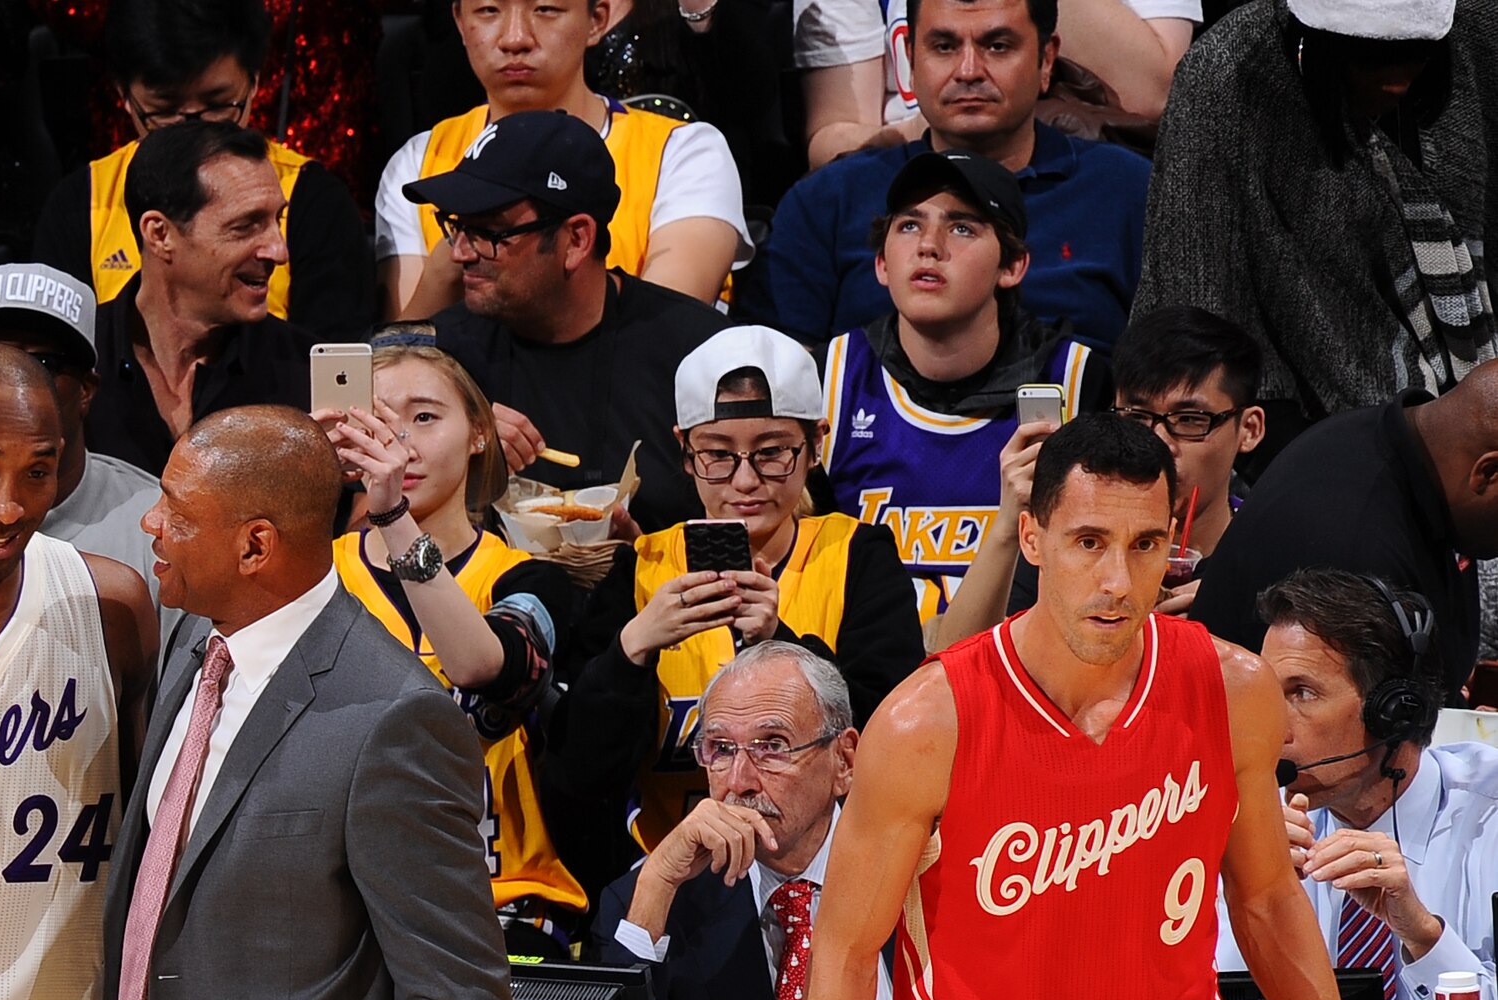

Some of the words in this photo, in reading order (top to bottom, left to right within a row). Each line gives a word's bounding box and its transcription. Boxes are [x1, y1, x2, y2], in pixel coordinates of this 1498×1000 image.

[5, 272, 83, 324] CLIPPERS
[1, 792, 116, 884] 24
[969, 760, 1209, 916] Clippers
[1159, 857, 1206, 946] 9
